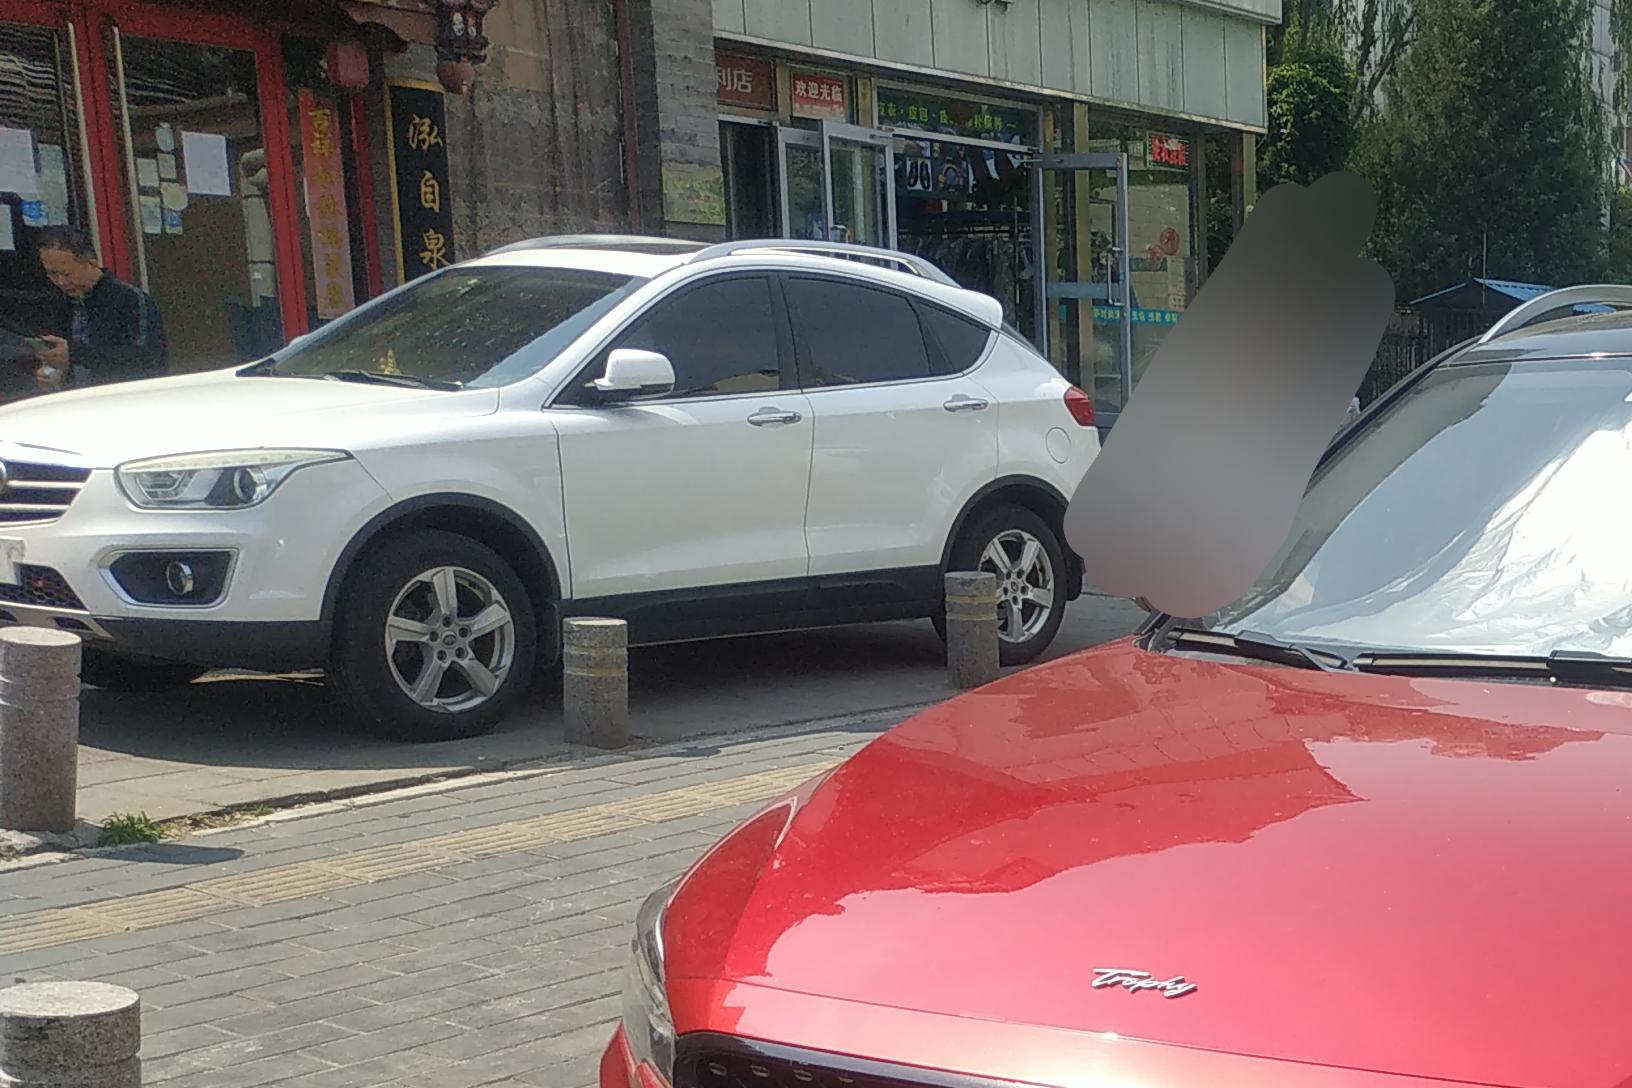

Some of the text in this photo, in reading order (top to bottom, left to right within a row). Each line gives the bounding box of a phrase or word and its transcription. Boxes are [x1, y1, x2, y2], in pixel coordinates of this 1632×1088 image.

[795, 79, 843, 102] 欢迎光临
[408, 113, 449, 269] 泓自泉
[1091, 967, 1197, 999] Trophy
